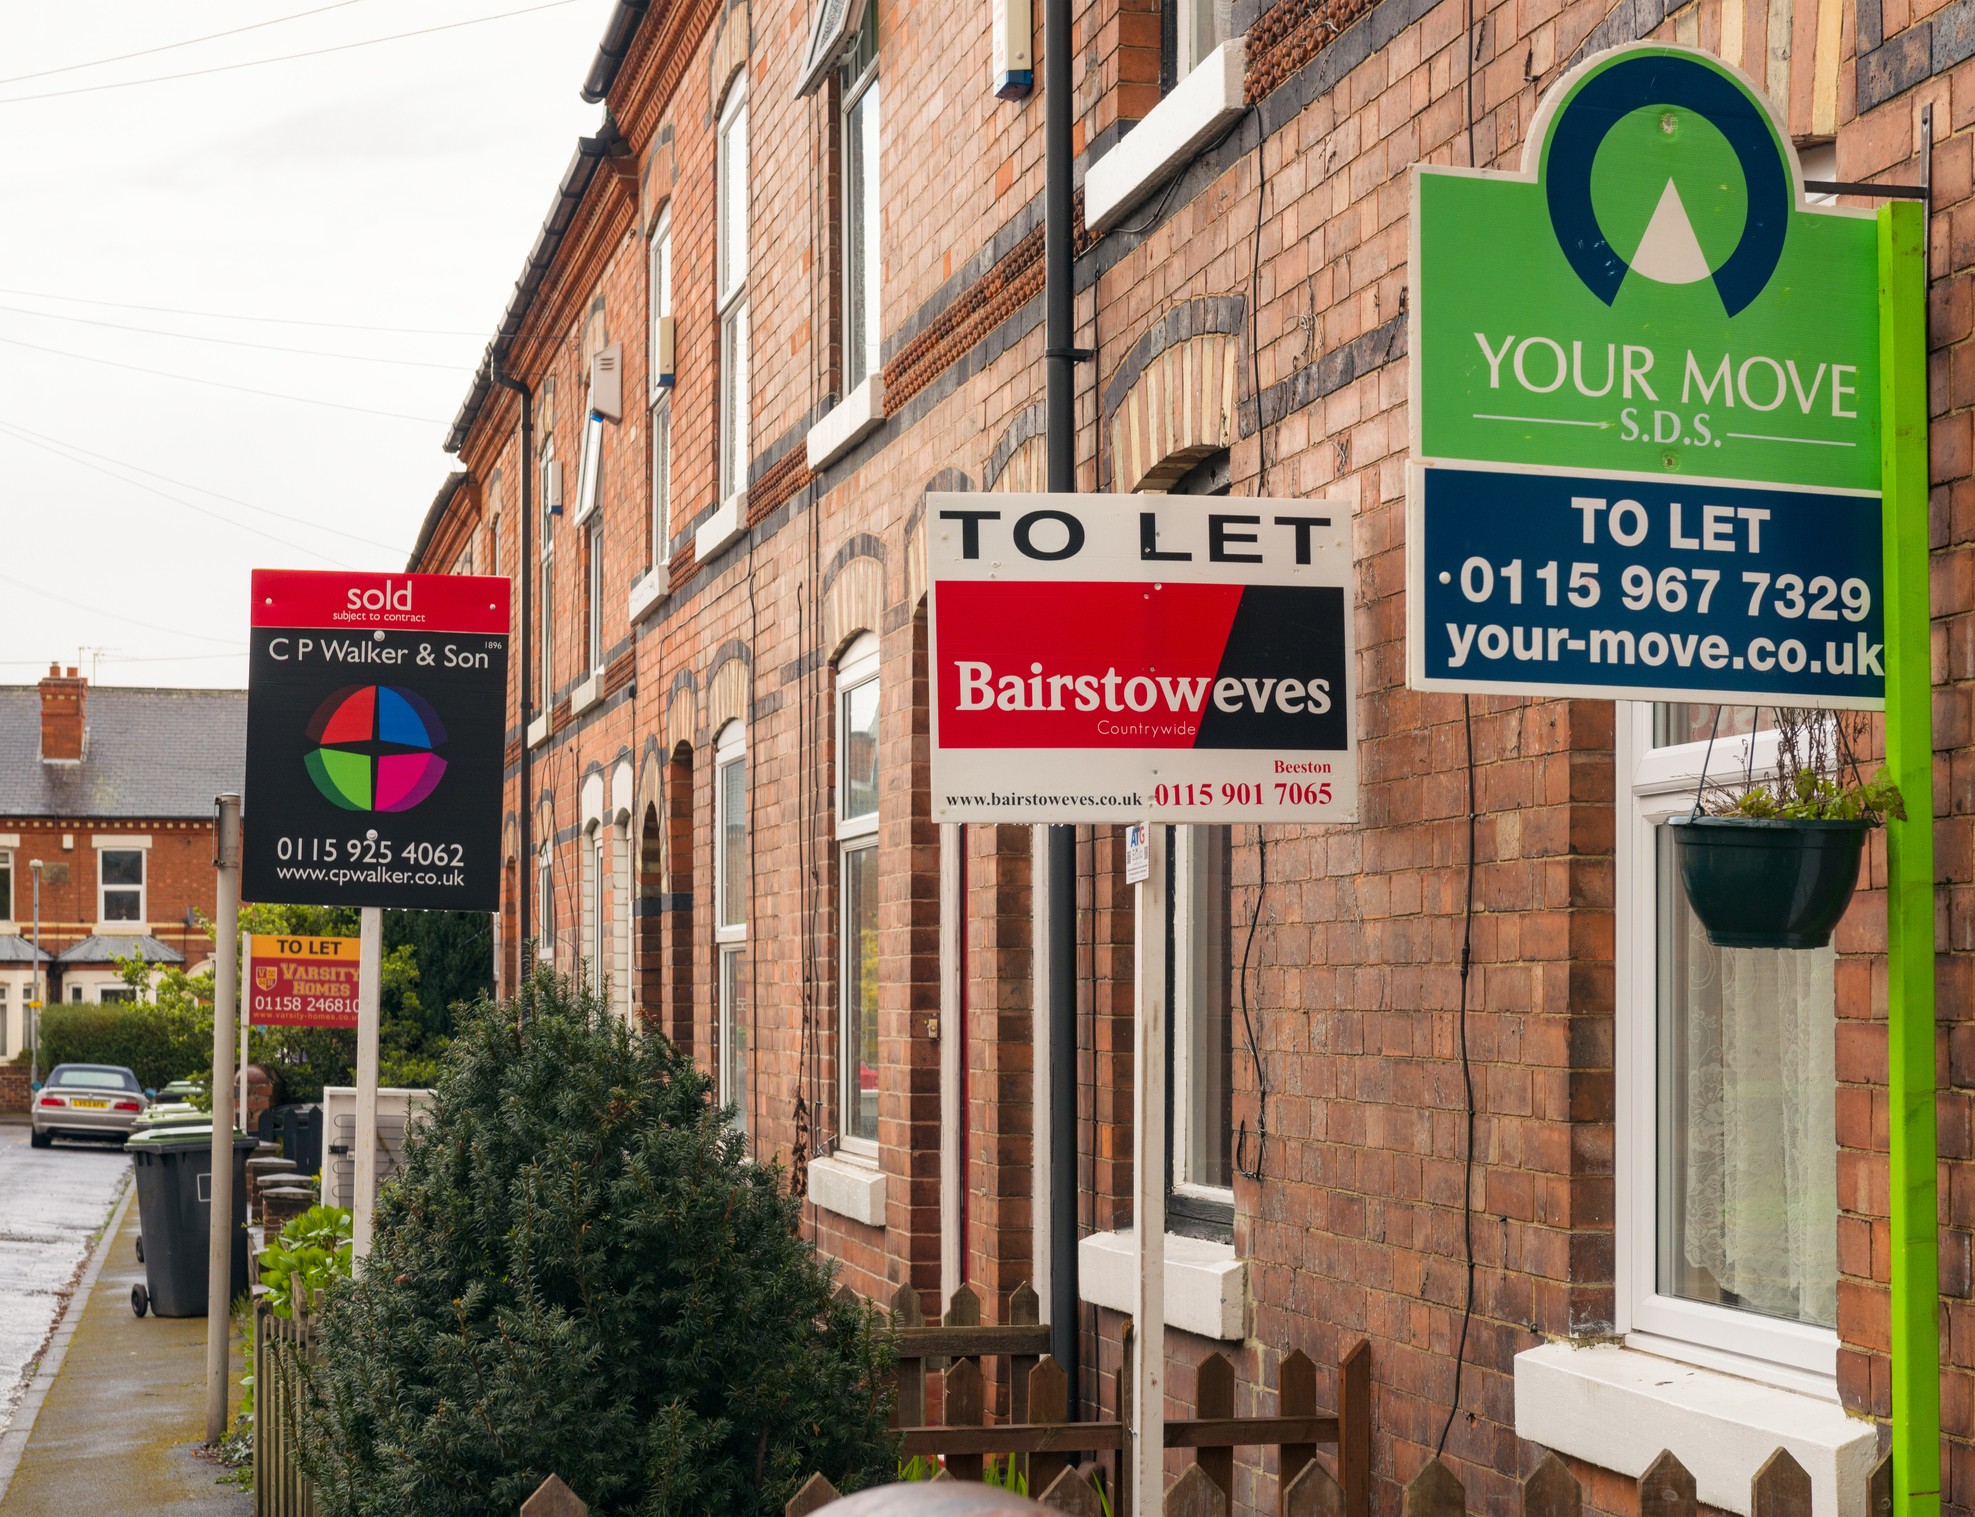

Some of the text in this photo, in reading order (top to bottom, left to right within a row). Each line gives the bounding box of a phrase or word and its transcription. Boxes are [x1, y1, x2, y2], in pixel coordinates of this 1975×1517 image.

[1474, 332, 1857, 418] YOUR MOVE
[1620, 408, 1722, 448] S.D.S.
[1571, 496, 1771, 554] TO LET
[939, 510, 1332, 565] TO LET
[347, 579, 413, 611] sold
[1460, 556, 1871, 622] 0115 967 7329
[332, 610, 426, 623] subject to contract
[268, 638, 489, 669] C P Walker & Son
[485, 641, 502, 650] 1896
[1446, 622, 1885, 677] your-move.co.uk
[1097, 719, 1197, 738] Countrywide
[1273, 760, 1332, 774] Beeston
[946, 792, 1143, 806] www.bairstoweves.co.uk
[1154, 782, 1332, 806] 0115 901 7065
[1130, 825, 1146, 848] ATG
[276, 836, 465, 867] 0115 925 4062
[276, 866, 465, 886] www.cpwalker.co.uk
[277, 939, 342, 955] TO LET
[255, 995, 301, 1011] 01158
[253, 1011, 358, 1021] www.varsity-homes.co.u
